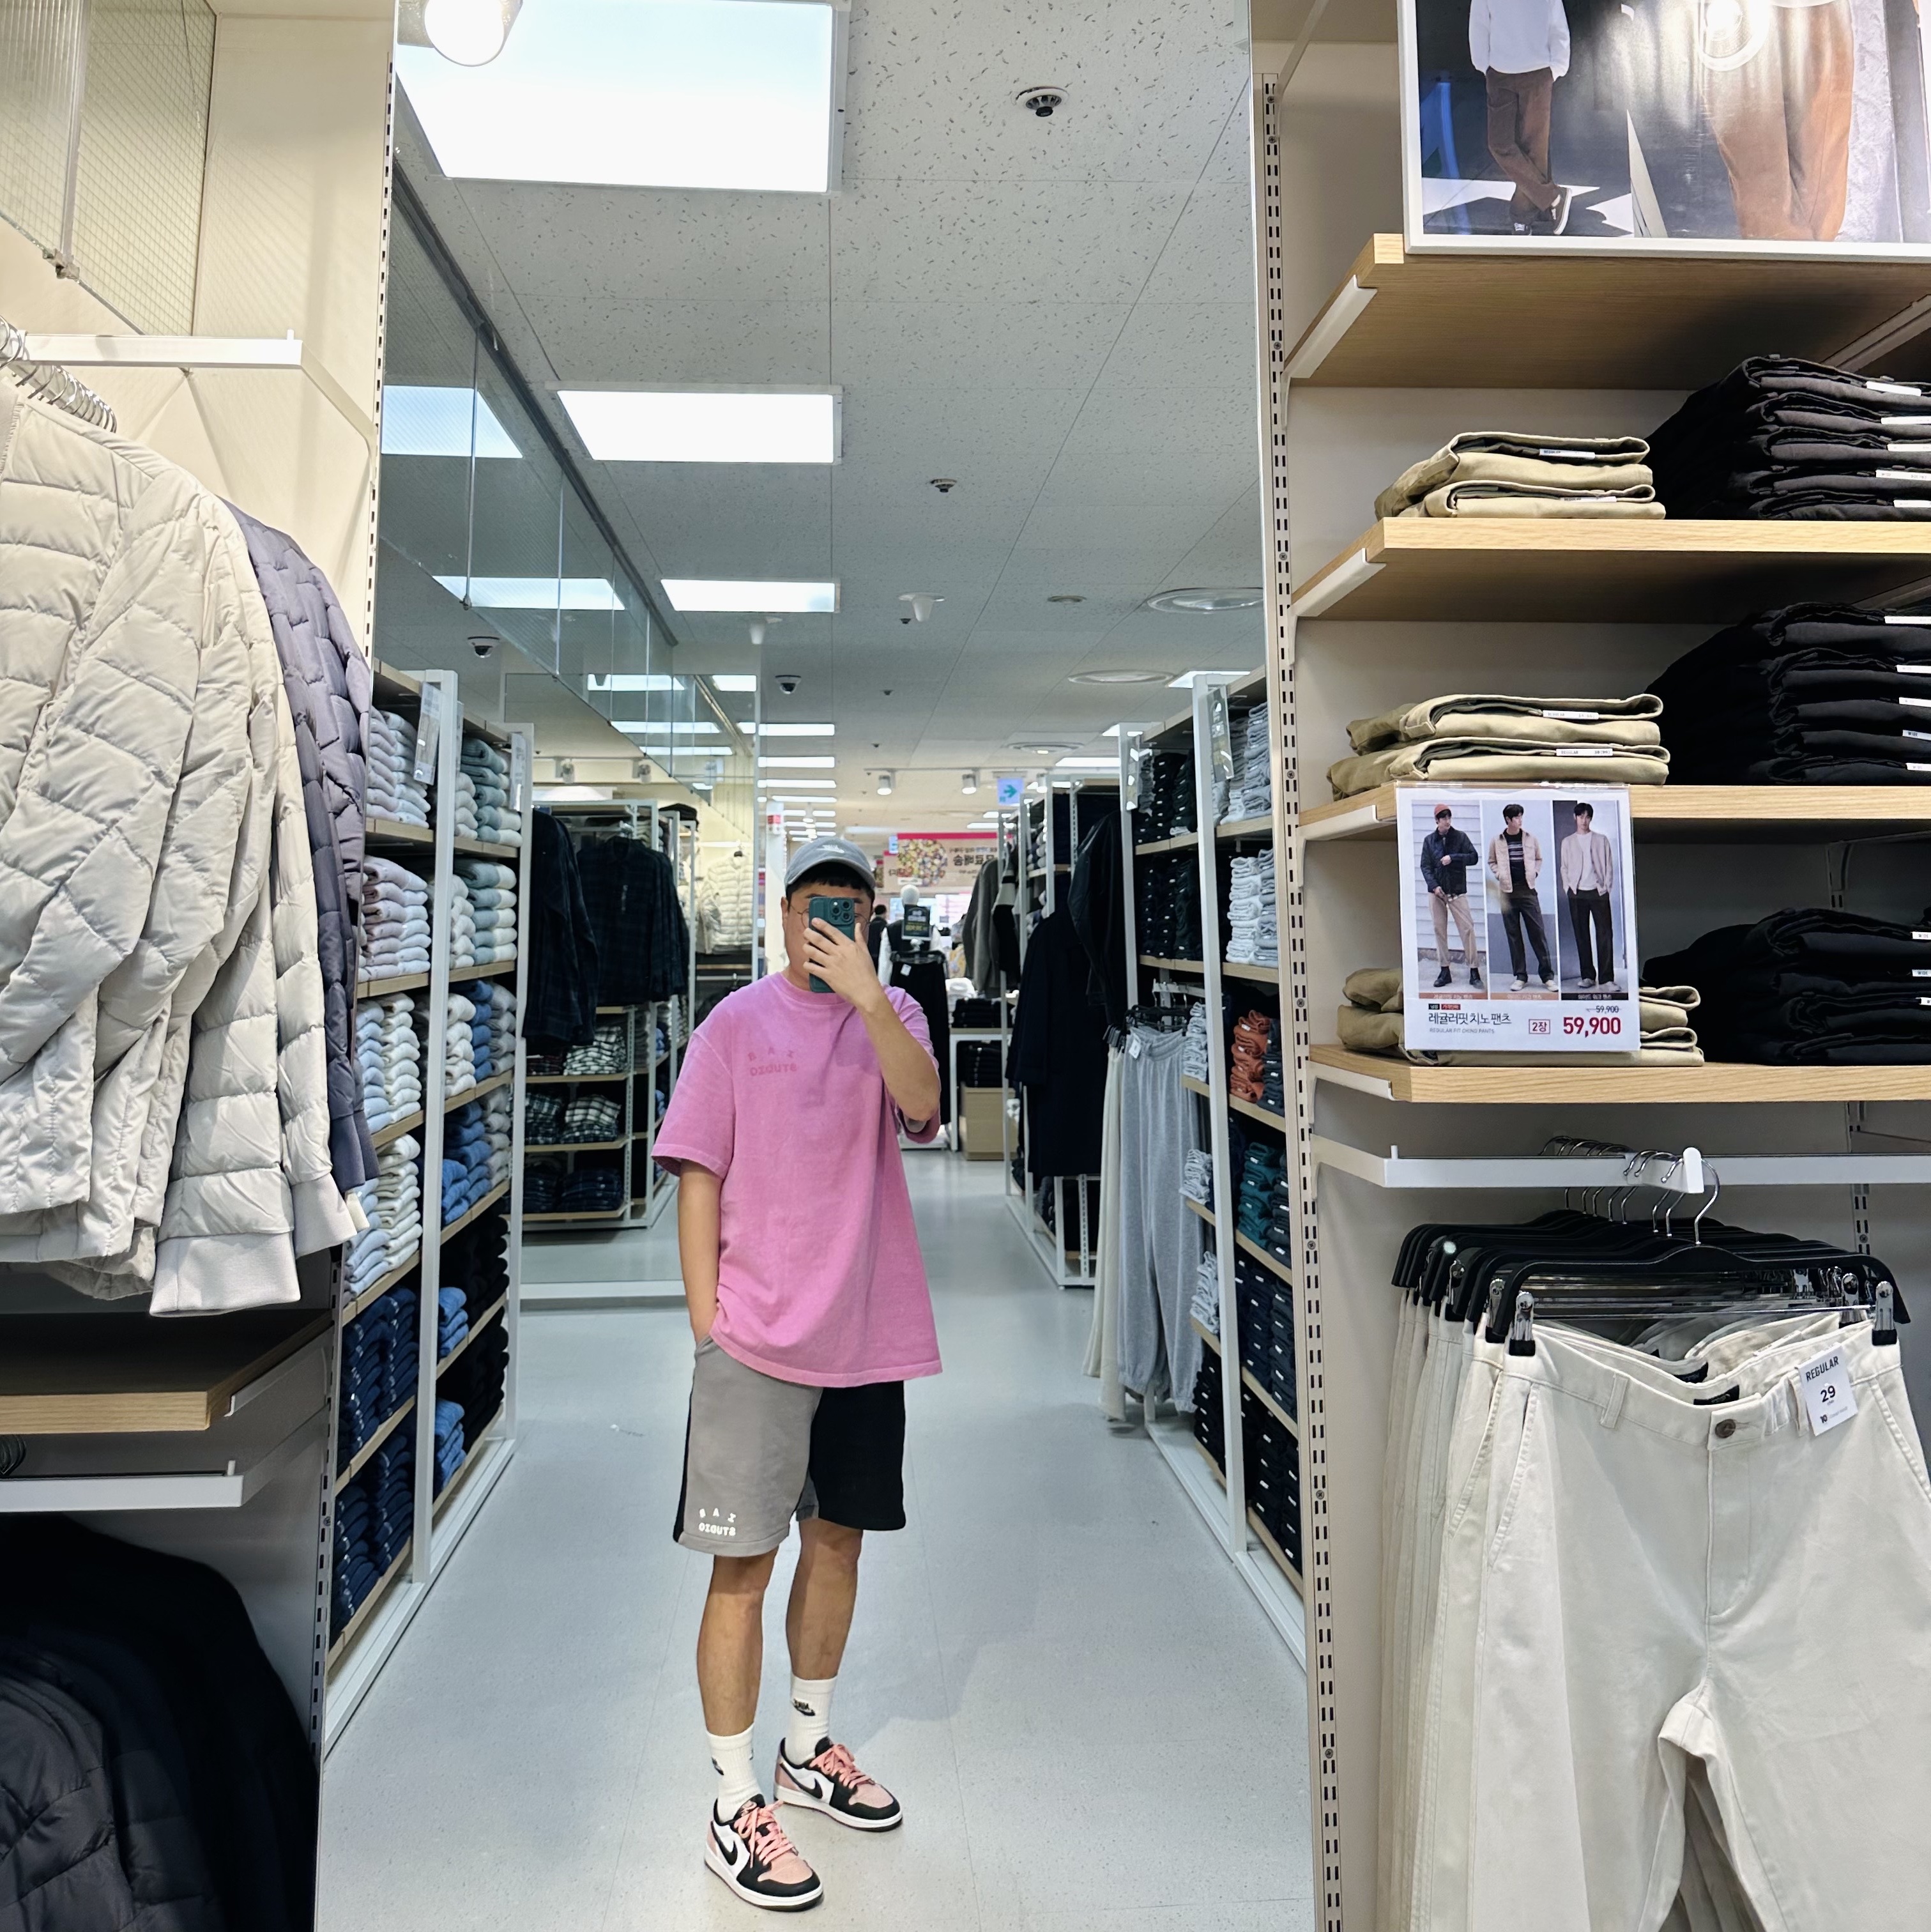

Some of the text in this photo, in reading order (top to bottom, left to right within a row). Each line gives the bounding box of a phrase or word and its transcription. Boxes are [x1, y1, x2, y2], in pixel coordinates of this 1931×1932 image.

[1596, 1006, 1619, 1014] 59,900
[1532, 1022, 1547, 1032] 2장
[1563, 1016, 1621, 1038] 59,900
[1806, 1356, 1839, 1383] REGULAR
[1820, 1385, 1836, 1402] 29
